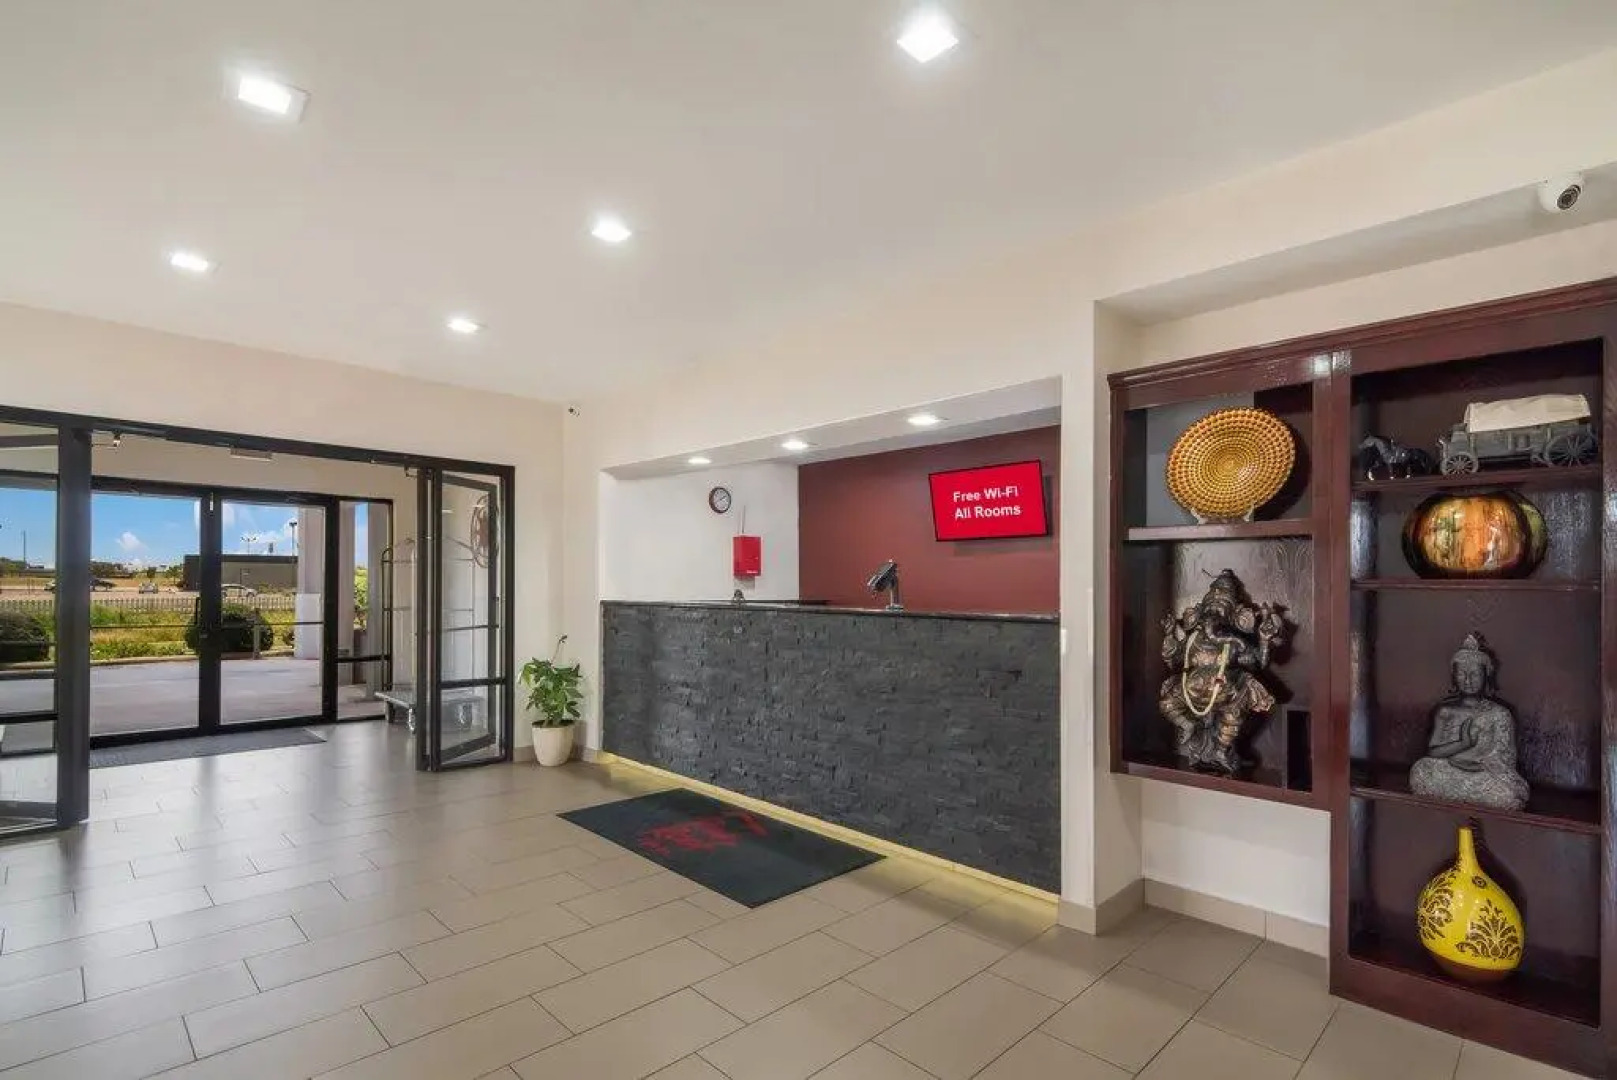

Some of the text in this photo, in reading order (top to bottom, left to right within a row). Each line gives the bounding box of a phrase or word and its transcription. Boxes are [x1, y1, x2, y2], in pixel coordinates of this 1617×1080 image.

[953, 491, 981, 502] Free
[955, 505, 1021, 519] All Rooms
